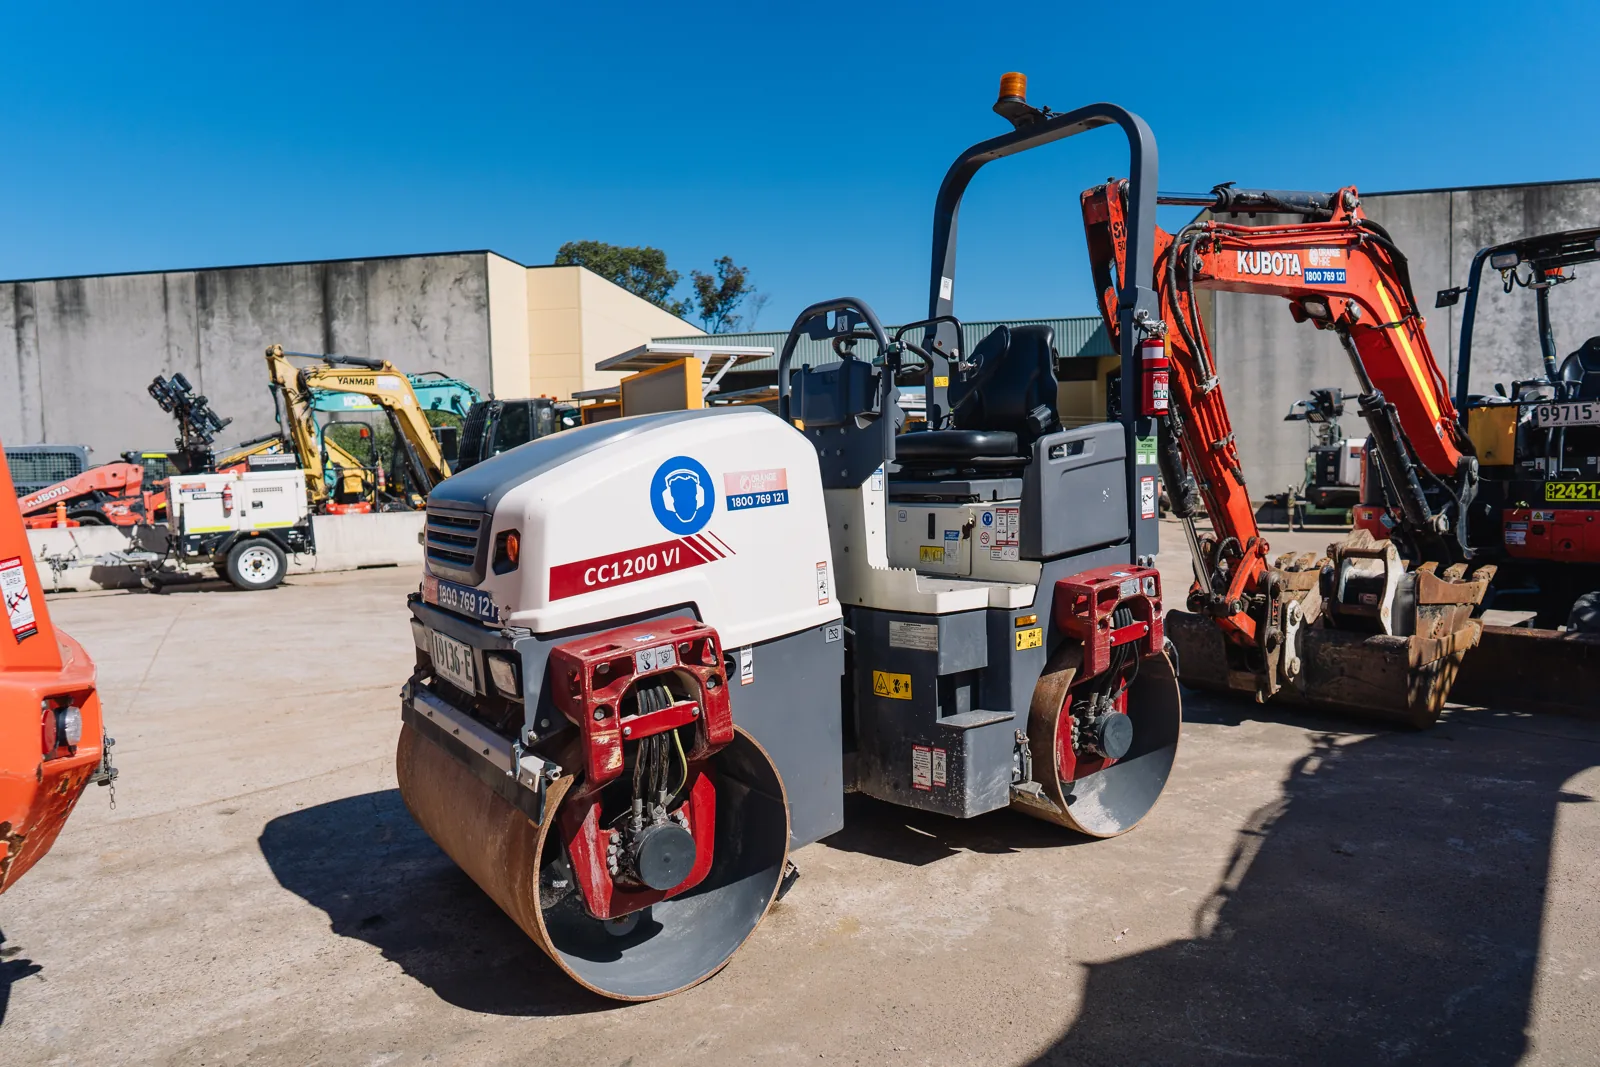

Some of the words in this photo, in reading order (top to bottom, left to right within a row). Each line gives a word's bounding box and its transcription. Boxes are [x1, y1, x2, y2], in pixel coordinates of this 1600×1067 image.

[1236, 250, 1302, 276] KUBOTA
[1305, 271, 1322, 281] 1800
[1323, 271, 1335, 281] 769
[1336, 271, 1346, 281] 121
[337, 376, 375, 385] YANMAR
[1555, 484, 1600, 499] 2421
[731, 496, 753, 507] 1800
[756, 494, 771, 504] 769
[773, 492, 785, 502] 121
[584, 553, 658, 586] CC1200
[662, 547, 680, 567] VI
[439, 584, 458, 606] 1800
[460, 591, 476, 612] 769
[478, 596, 495, 617] 121
